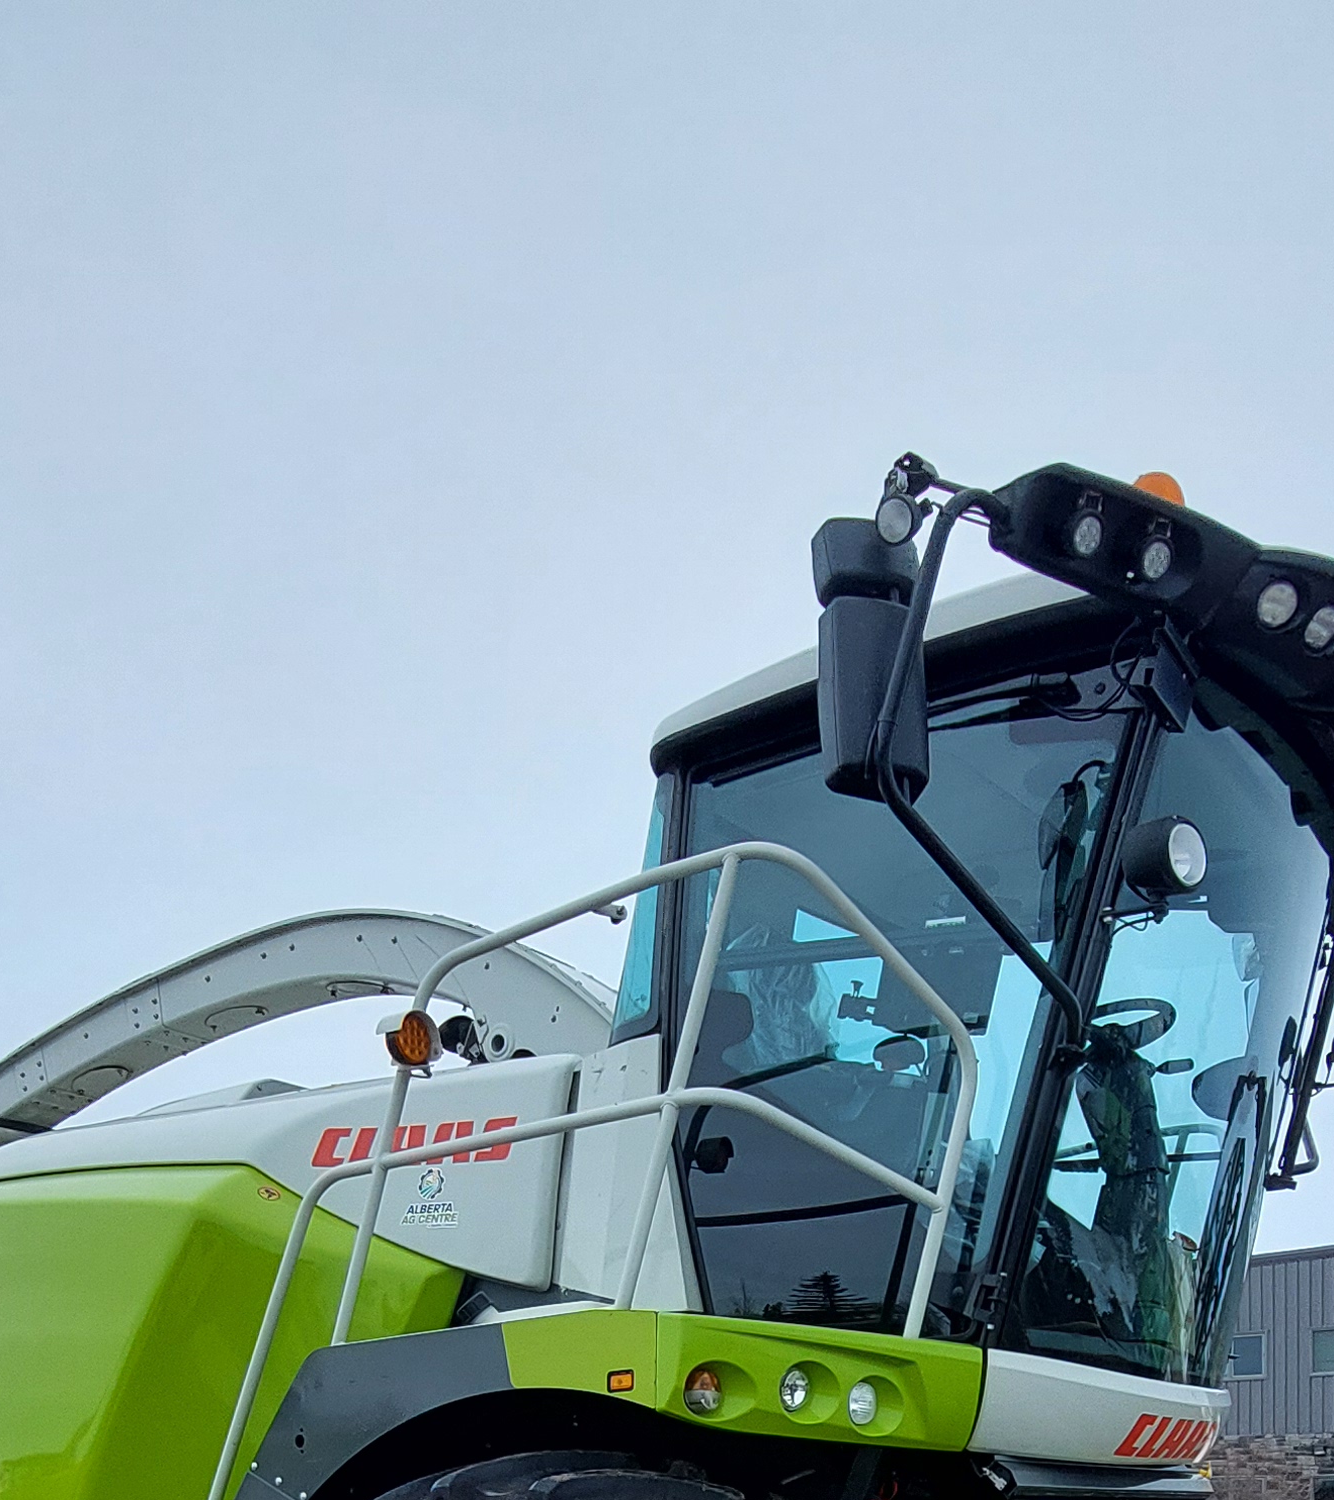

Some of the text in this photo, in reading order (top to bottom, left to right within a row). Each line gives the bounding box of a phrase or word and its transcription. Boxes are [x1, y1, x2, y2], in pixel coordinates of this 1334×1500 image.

[406, 1203, 453, 1214] ALBERTA
[401, 1213, 458, 1225] AG CENTRE
